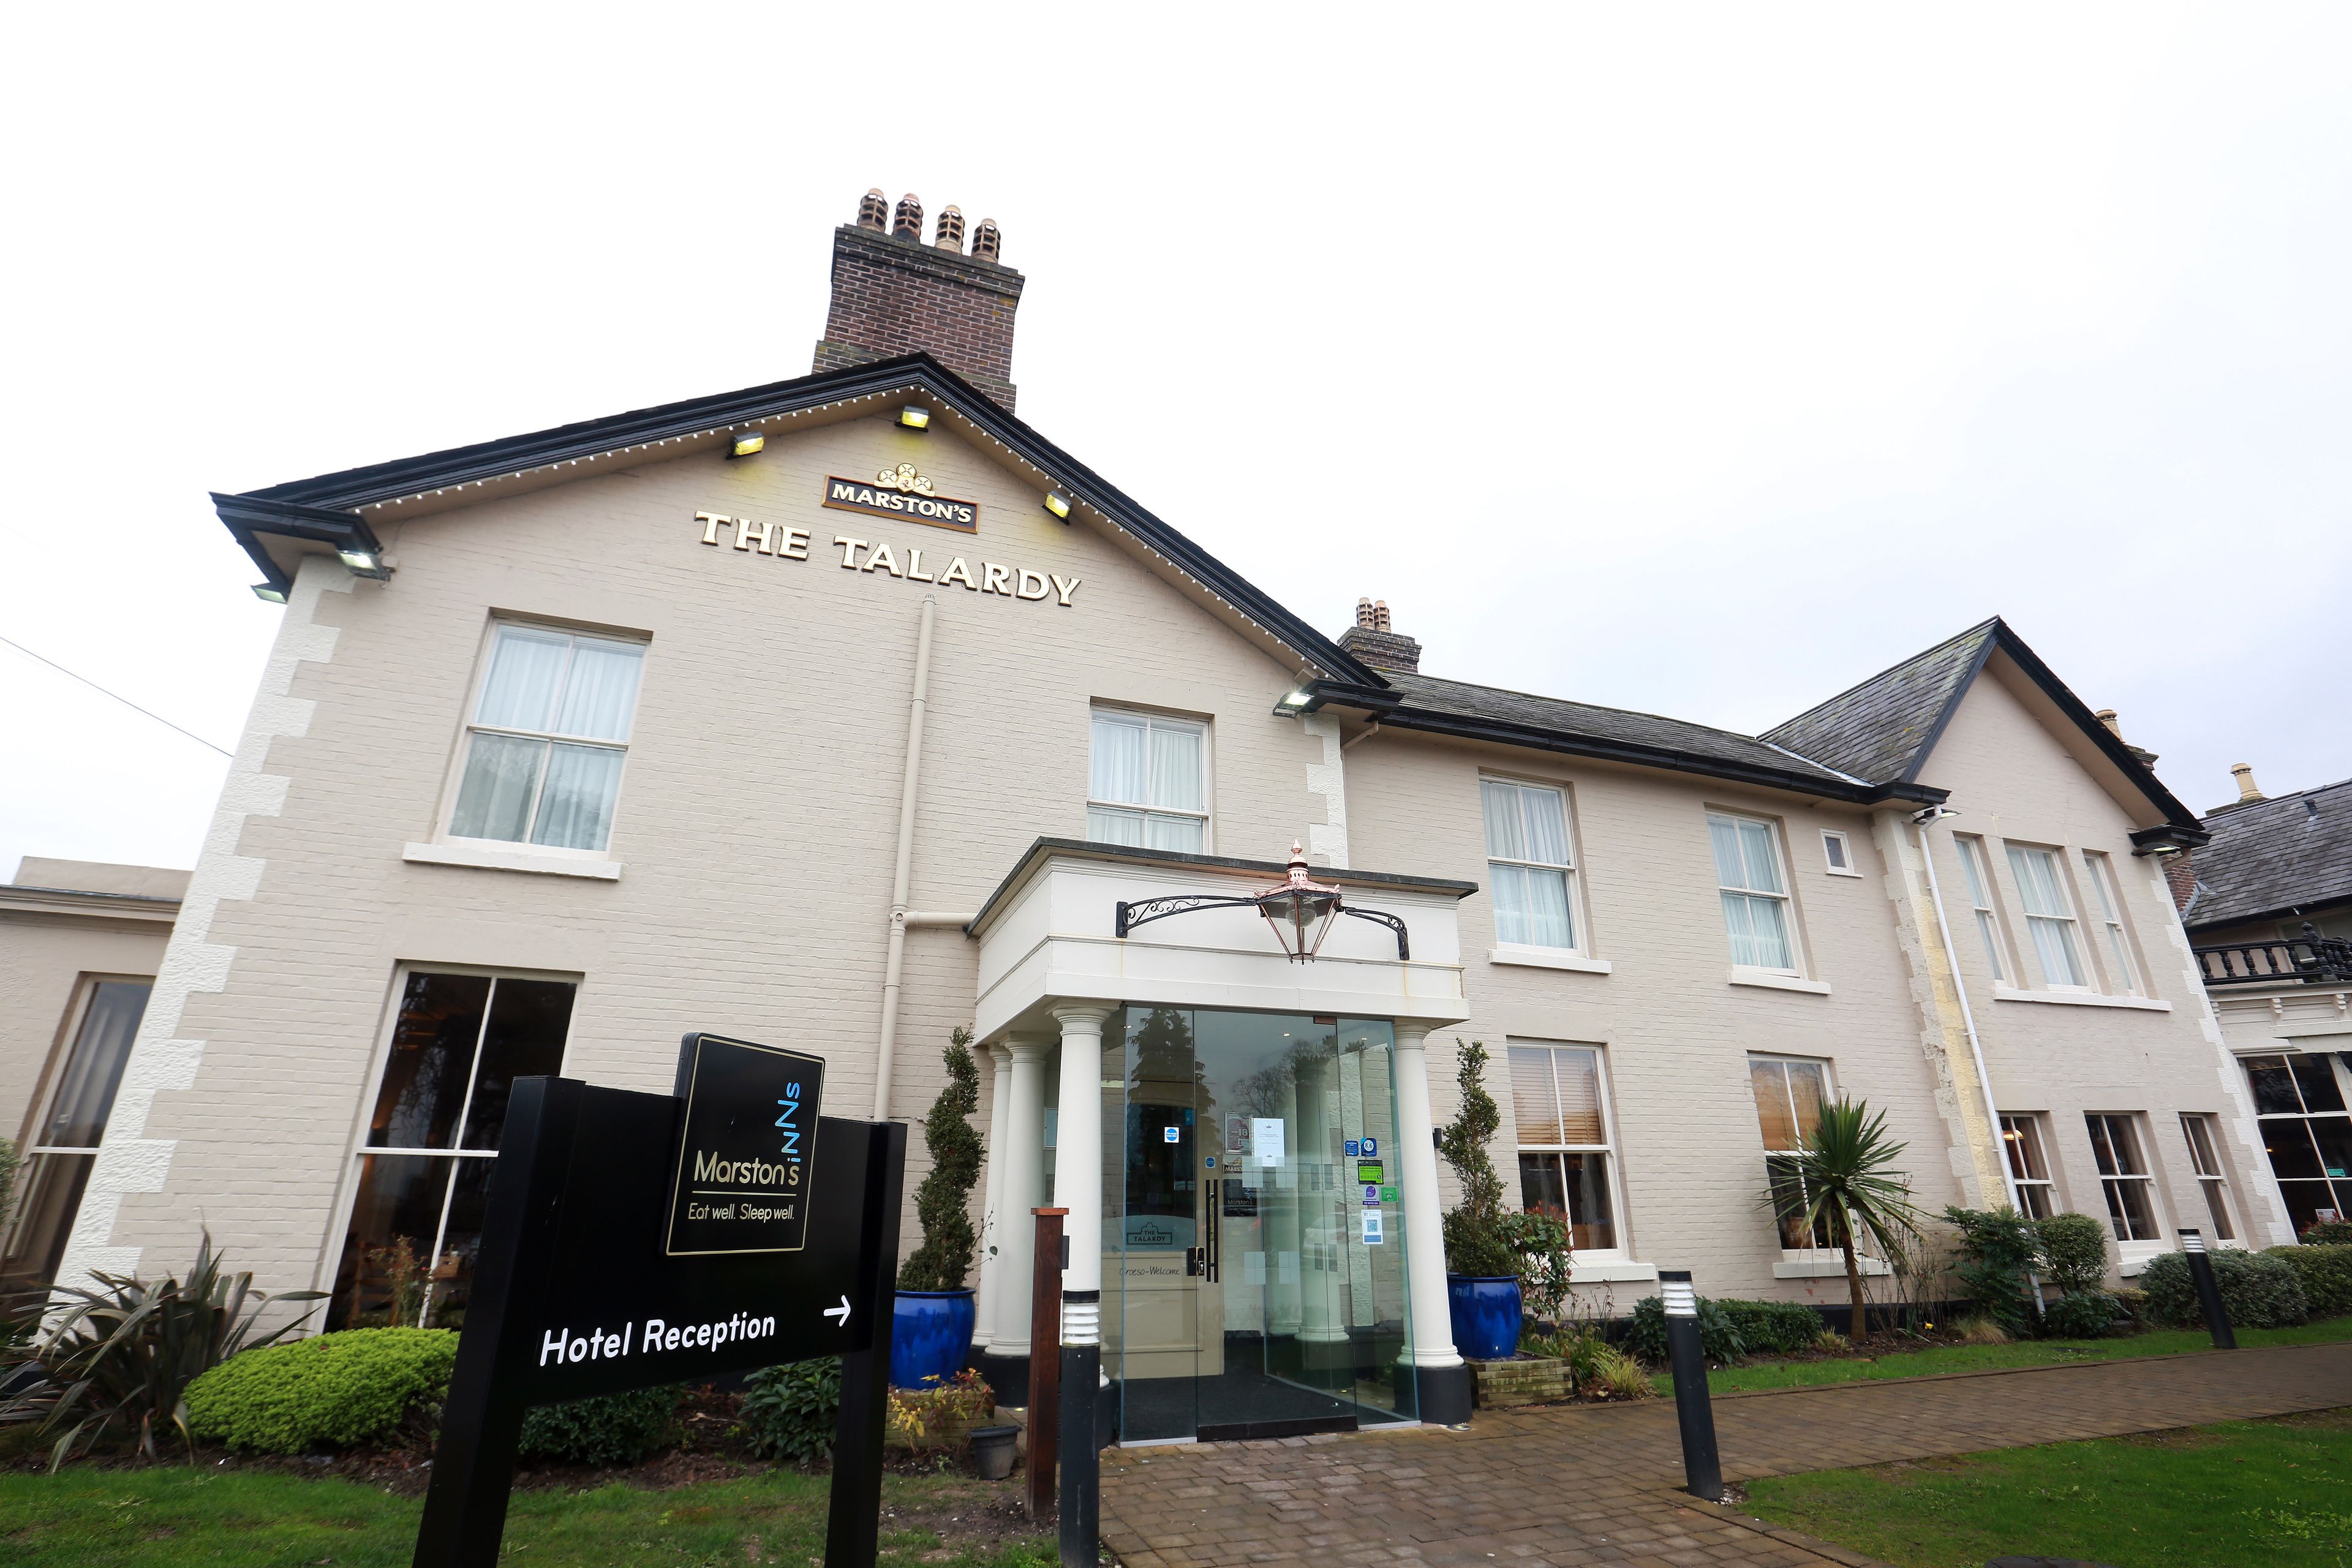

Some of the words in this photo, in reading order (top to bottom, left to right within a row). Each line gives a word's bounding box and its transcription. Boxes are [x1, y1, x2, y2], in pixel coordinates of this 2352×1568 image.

[831, 483, 972, 524] MARSTON'S
[694, 510, 812, 562] THE
[833, 533, 1082, 608] TALARDY
[688, 1202, 710, 1220] Eat
[712, 1204, 736, 1220] well.
[739, 1203, 771, 1224] Sleep
[773, 1204, 794, 1219] well.
[539, 1321, 632, 1367] Hotel
[643, 1311, 776, 1352] Reception
